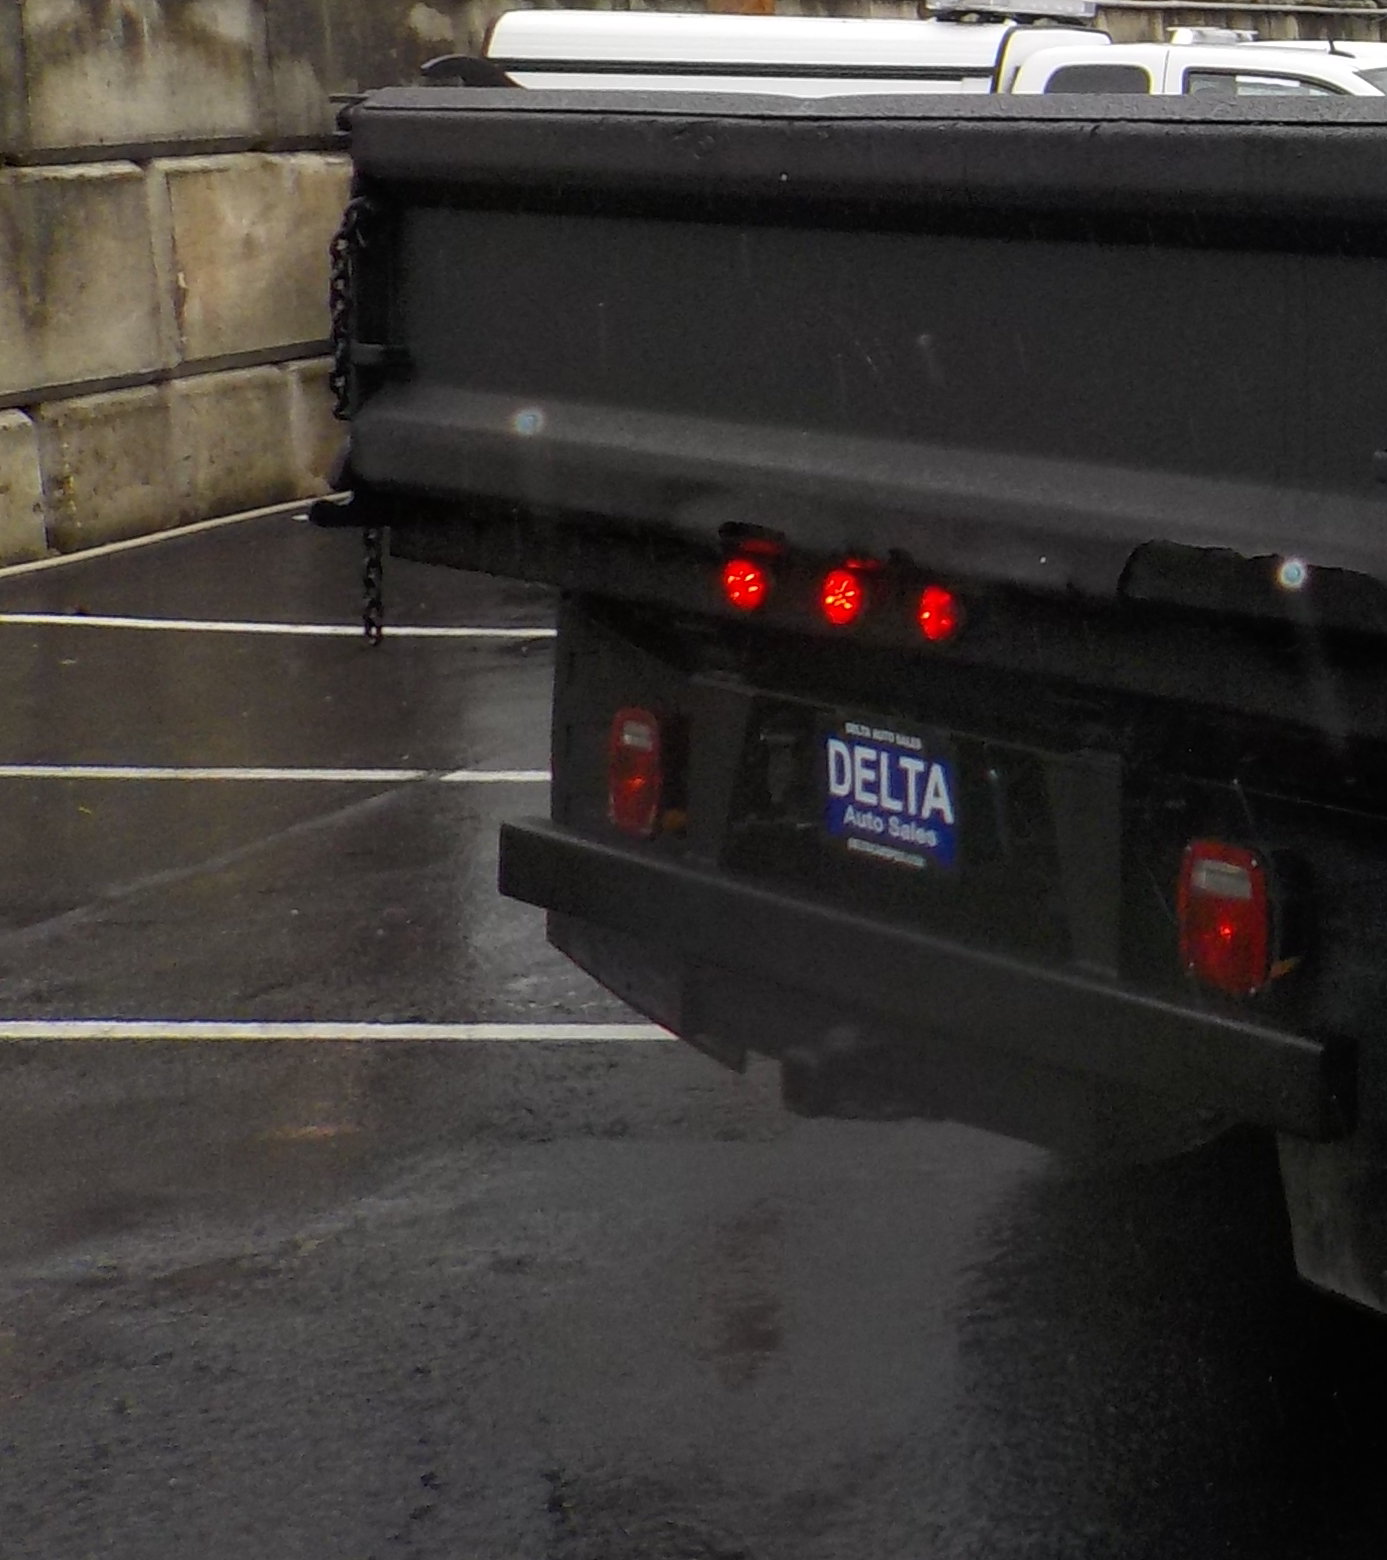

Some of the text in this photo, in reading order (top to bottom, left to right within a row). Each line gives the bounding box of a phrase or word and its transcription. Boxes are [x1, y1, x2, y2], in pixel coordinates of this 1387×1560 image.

[827, 738, 955, 825] DELTA
[843, 804, 939, 848] Auto Sales
